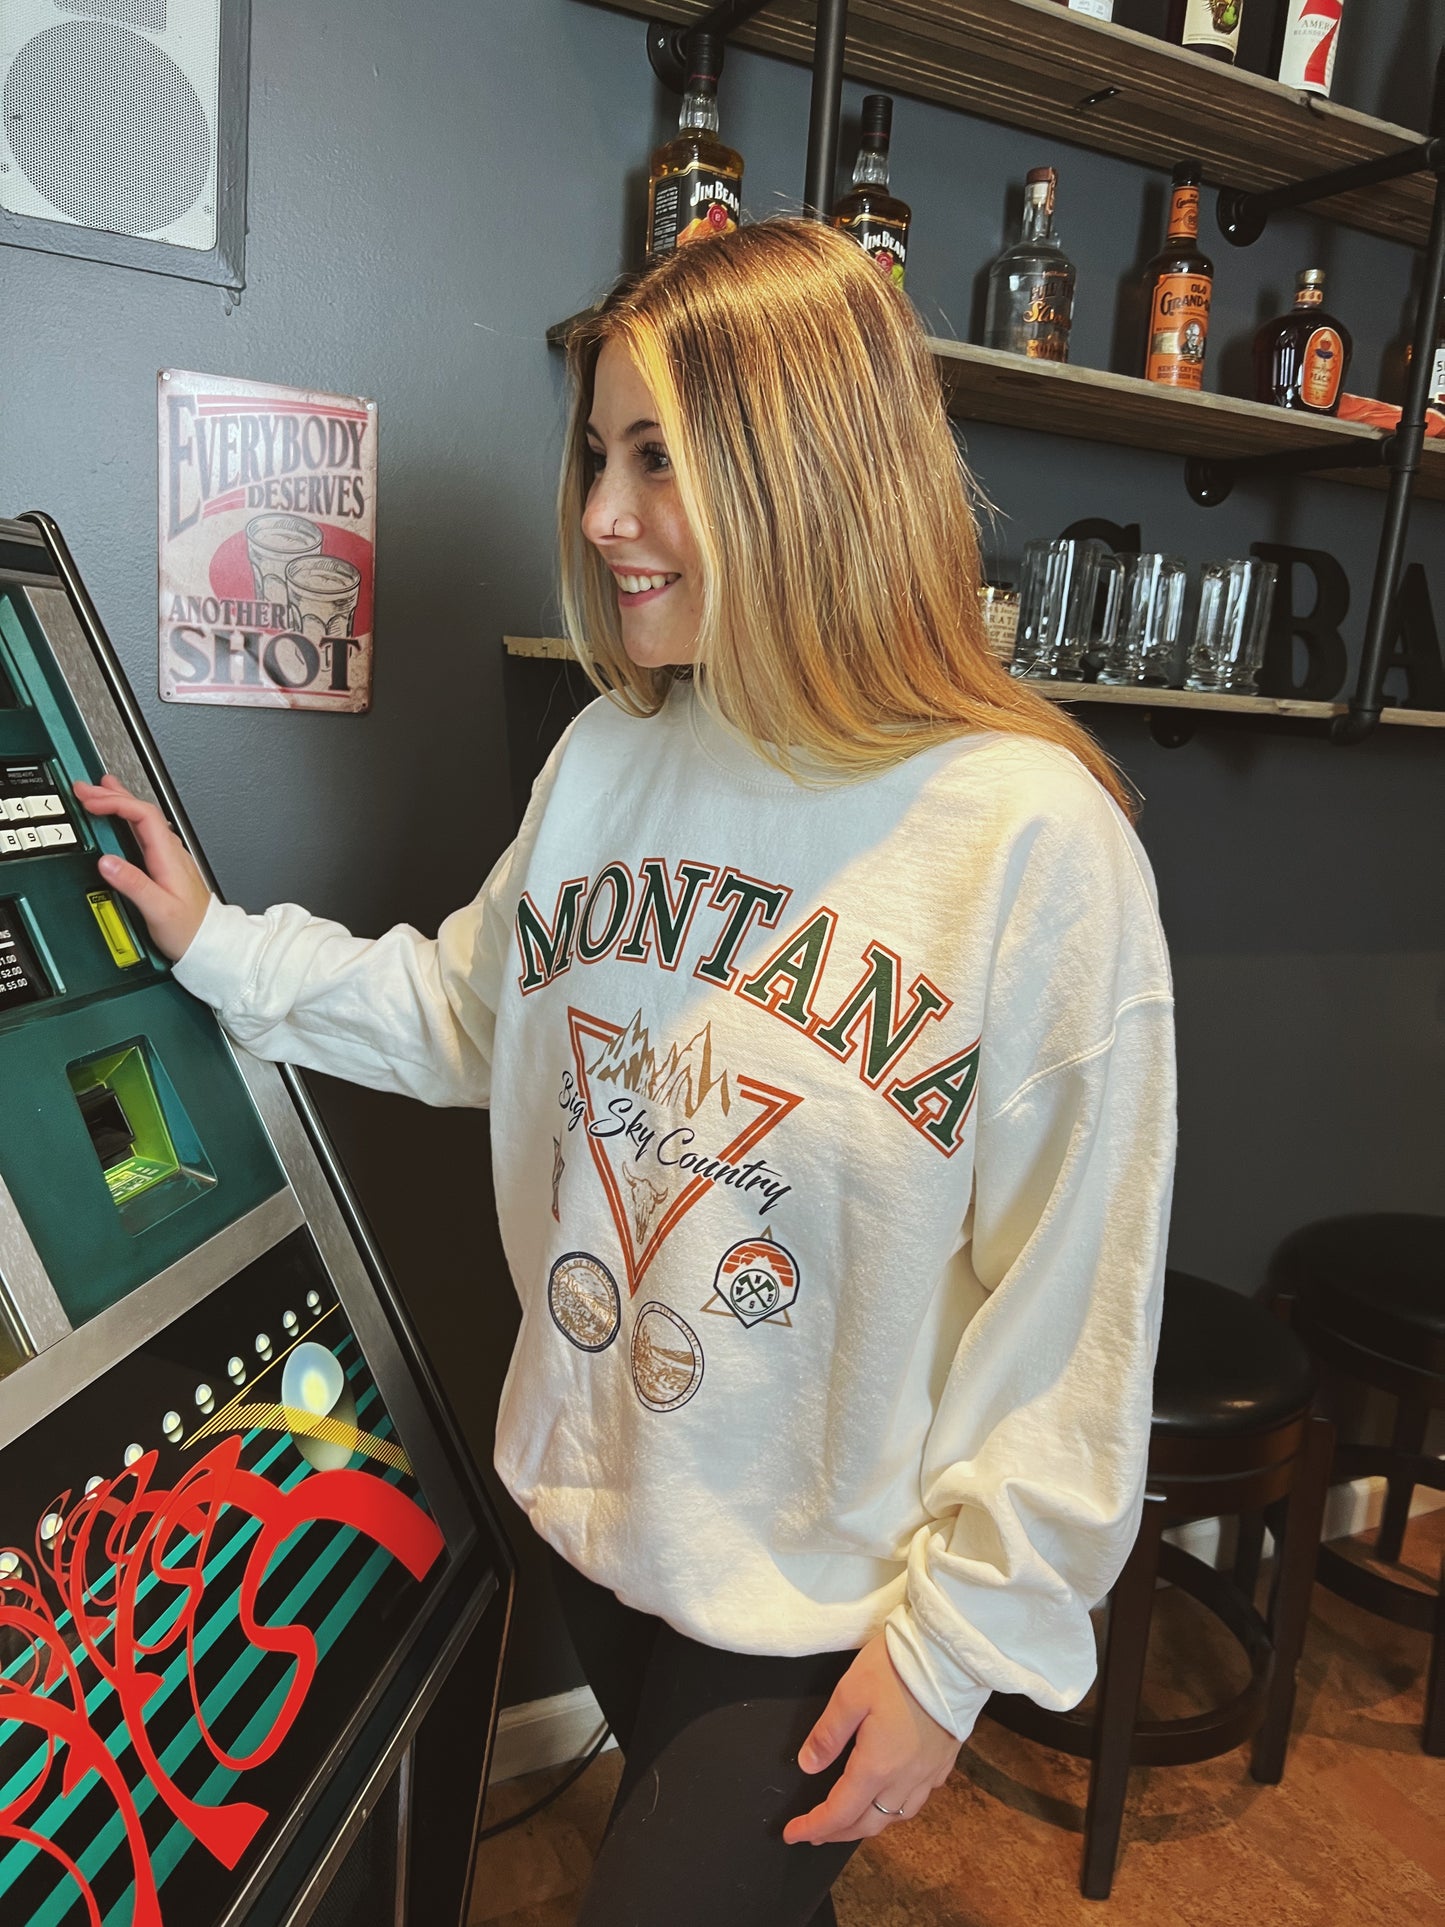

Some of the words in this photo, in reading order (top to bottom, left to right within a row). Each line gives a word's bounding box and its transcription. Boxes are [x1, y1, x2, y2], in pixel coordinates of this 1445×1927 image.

[690, 181, 714, 207] JIM
[167, 395, 368, 541] EVERYBODY
[248, 475, 365, 520] DESERVES
[169, 594, 289, 630] ANOTHER
[168, 624, 362, 692] SHOT
[7, 835, 16, 845] 8
[27, 832, 37, 842] 9
[0, 954, 17, 966] 1.00
[515, 857, 982, 1160] MONTANA
[558, 1070, 587, 1132] Big
[588, 1097, 657, 1162] Sky
[656, 1127, 793, 1216] Country
[735, 1286, 744, 1295] W
[766, 1293, 774, 1303] E
[754, 1274, 762, 1285] N
[749, 1300, 756, 1309] S
